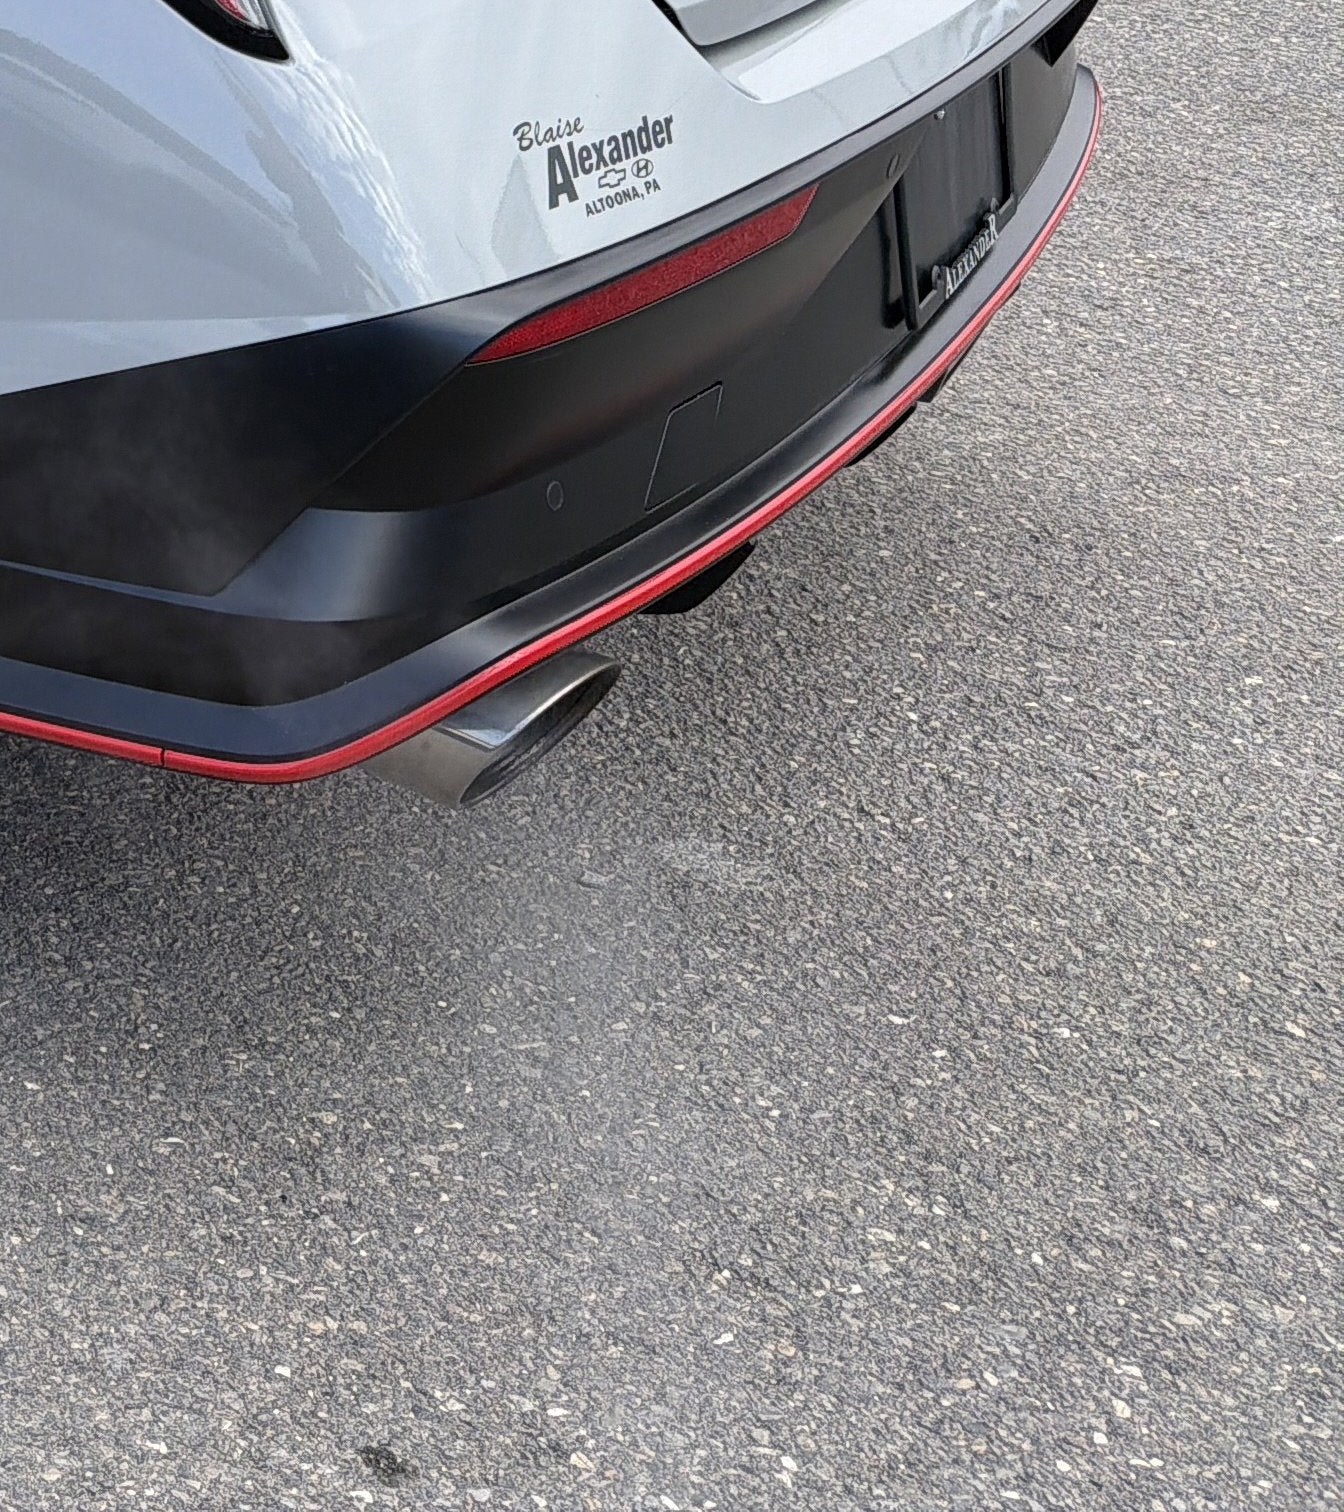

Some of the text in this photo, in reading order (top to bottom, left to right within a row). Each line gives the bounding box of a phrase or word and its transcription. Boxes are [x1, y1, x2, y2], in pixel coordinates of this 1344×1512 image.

[513, 116, 585, 152] Blaise
[547, 114, 674, 210] Alexander
[585, 178, 662, 217] ALTOONA, PA
[943, 212, 999, 300] ALEXANDER
